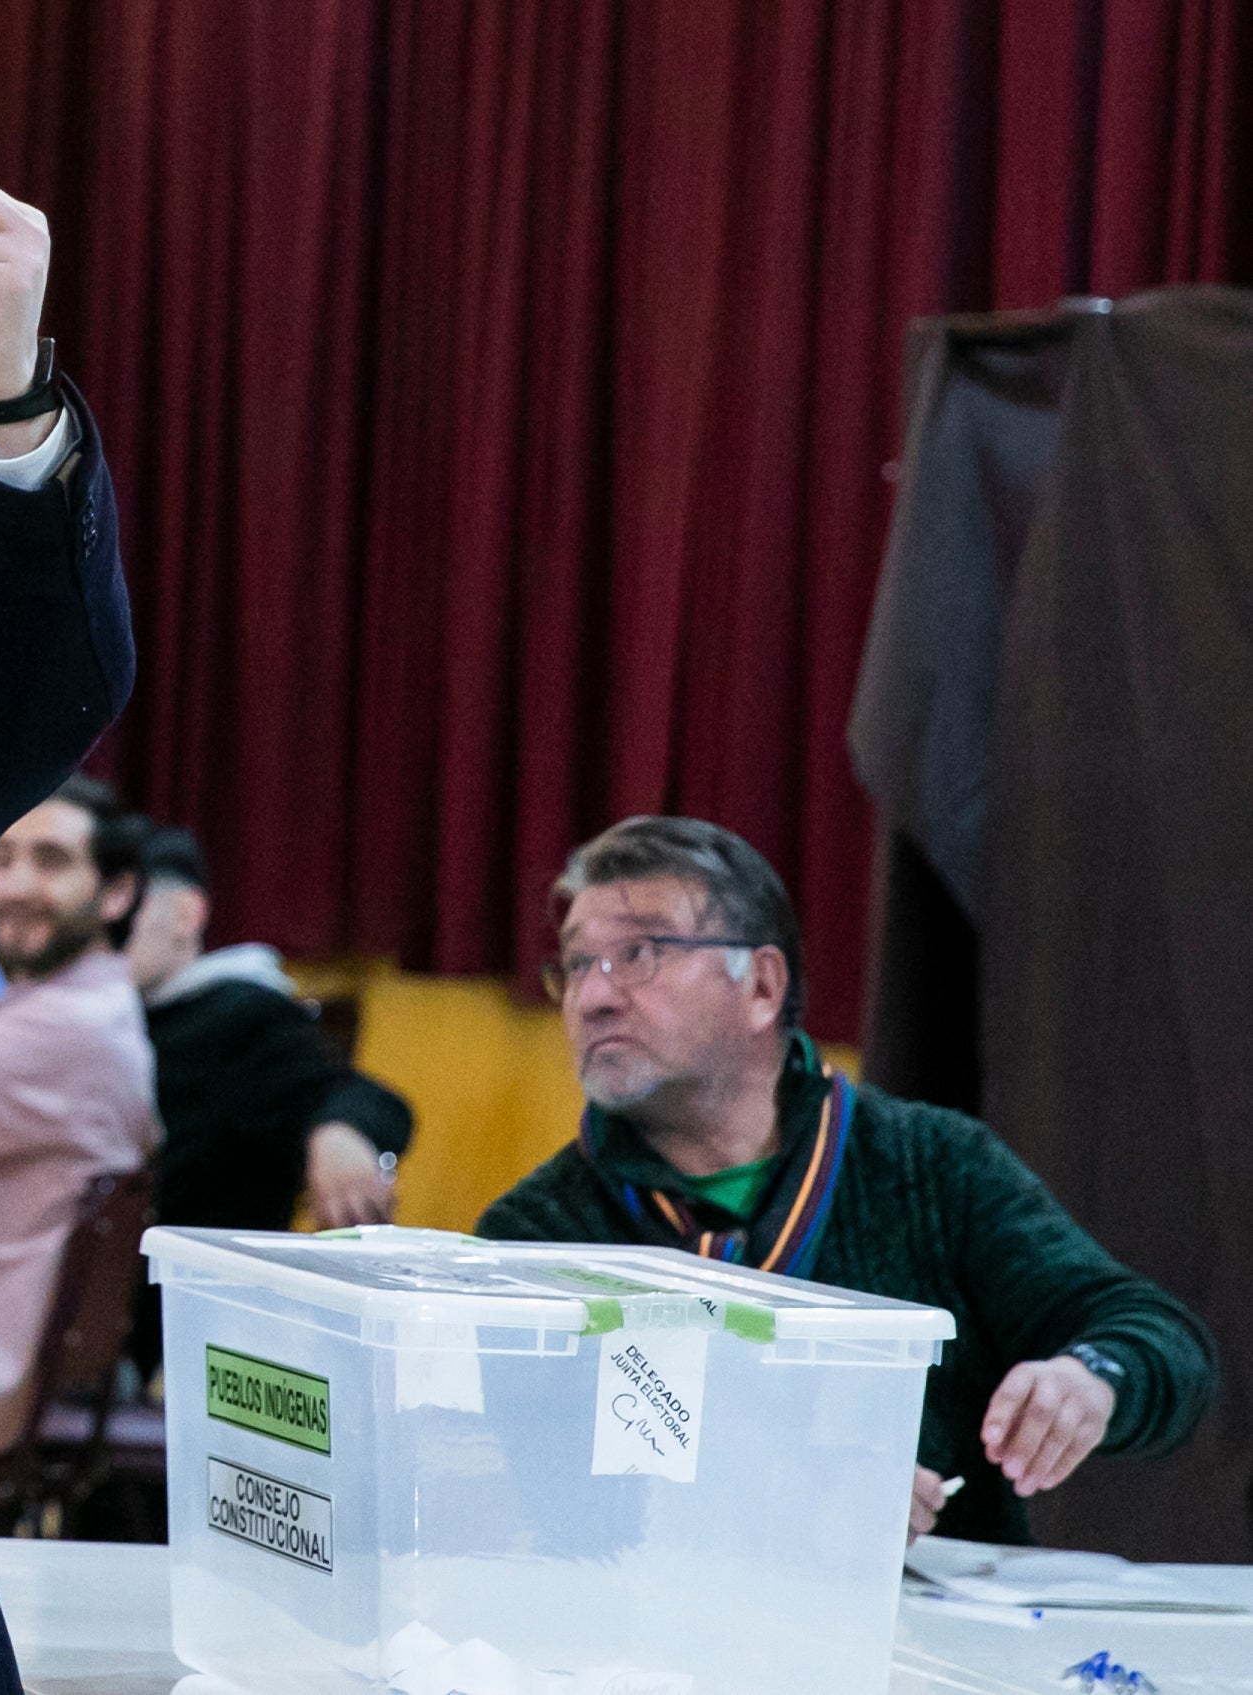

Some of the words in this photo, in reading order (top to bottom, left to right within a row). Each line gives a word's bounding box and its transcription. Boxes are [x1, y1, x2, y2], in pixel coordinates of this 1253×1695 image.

[209, 1365, 261, 1414] PUEBLOS
[264, 1378, 327, 1435] INDÍGENAS
[610, 1353, 641, 1386] JUNTA
[639, 1383, 691, 1449] ELECTORAL
[626, 1345, 690, 1423] DELEGADO
[210, 1495, 330, 1565] CONSTITUCIONAL
[236, 1473, 300, 1521] CONSEJO
